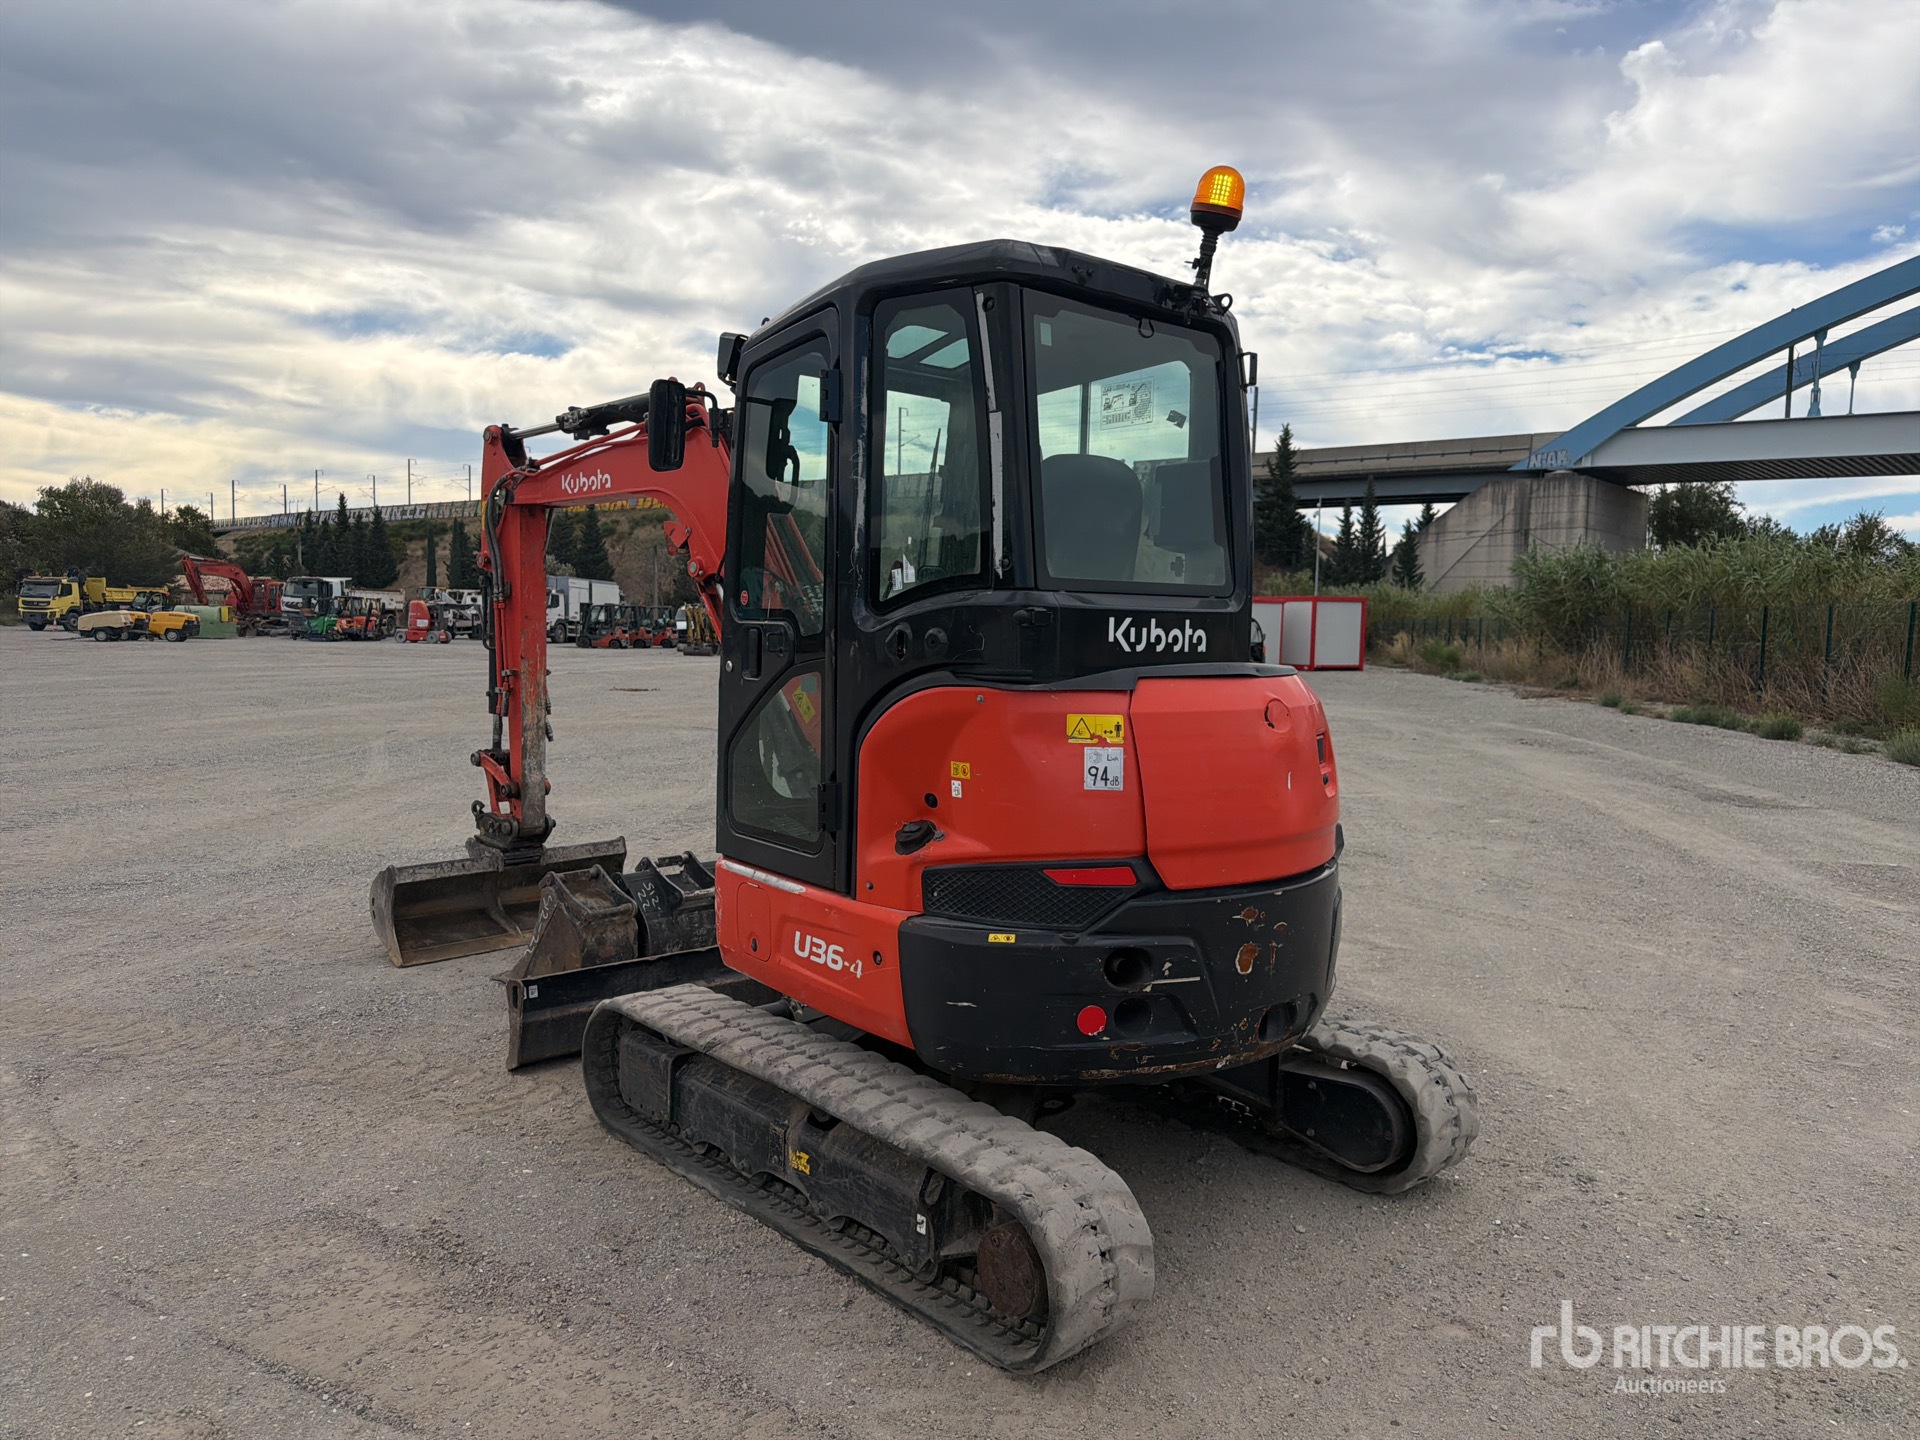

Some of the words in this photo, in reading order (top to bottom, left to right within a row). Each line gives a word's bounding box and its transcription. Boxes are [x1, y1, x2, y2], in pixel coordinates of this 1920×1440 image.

[561, 469, 611, 494] Kubota
[1108, 617, 1207, 652] Kubota
[1088, 766, 1109, 787] 94
[794, 930, 863, 979] U36-4
